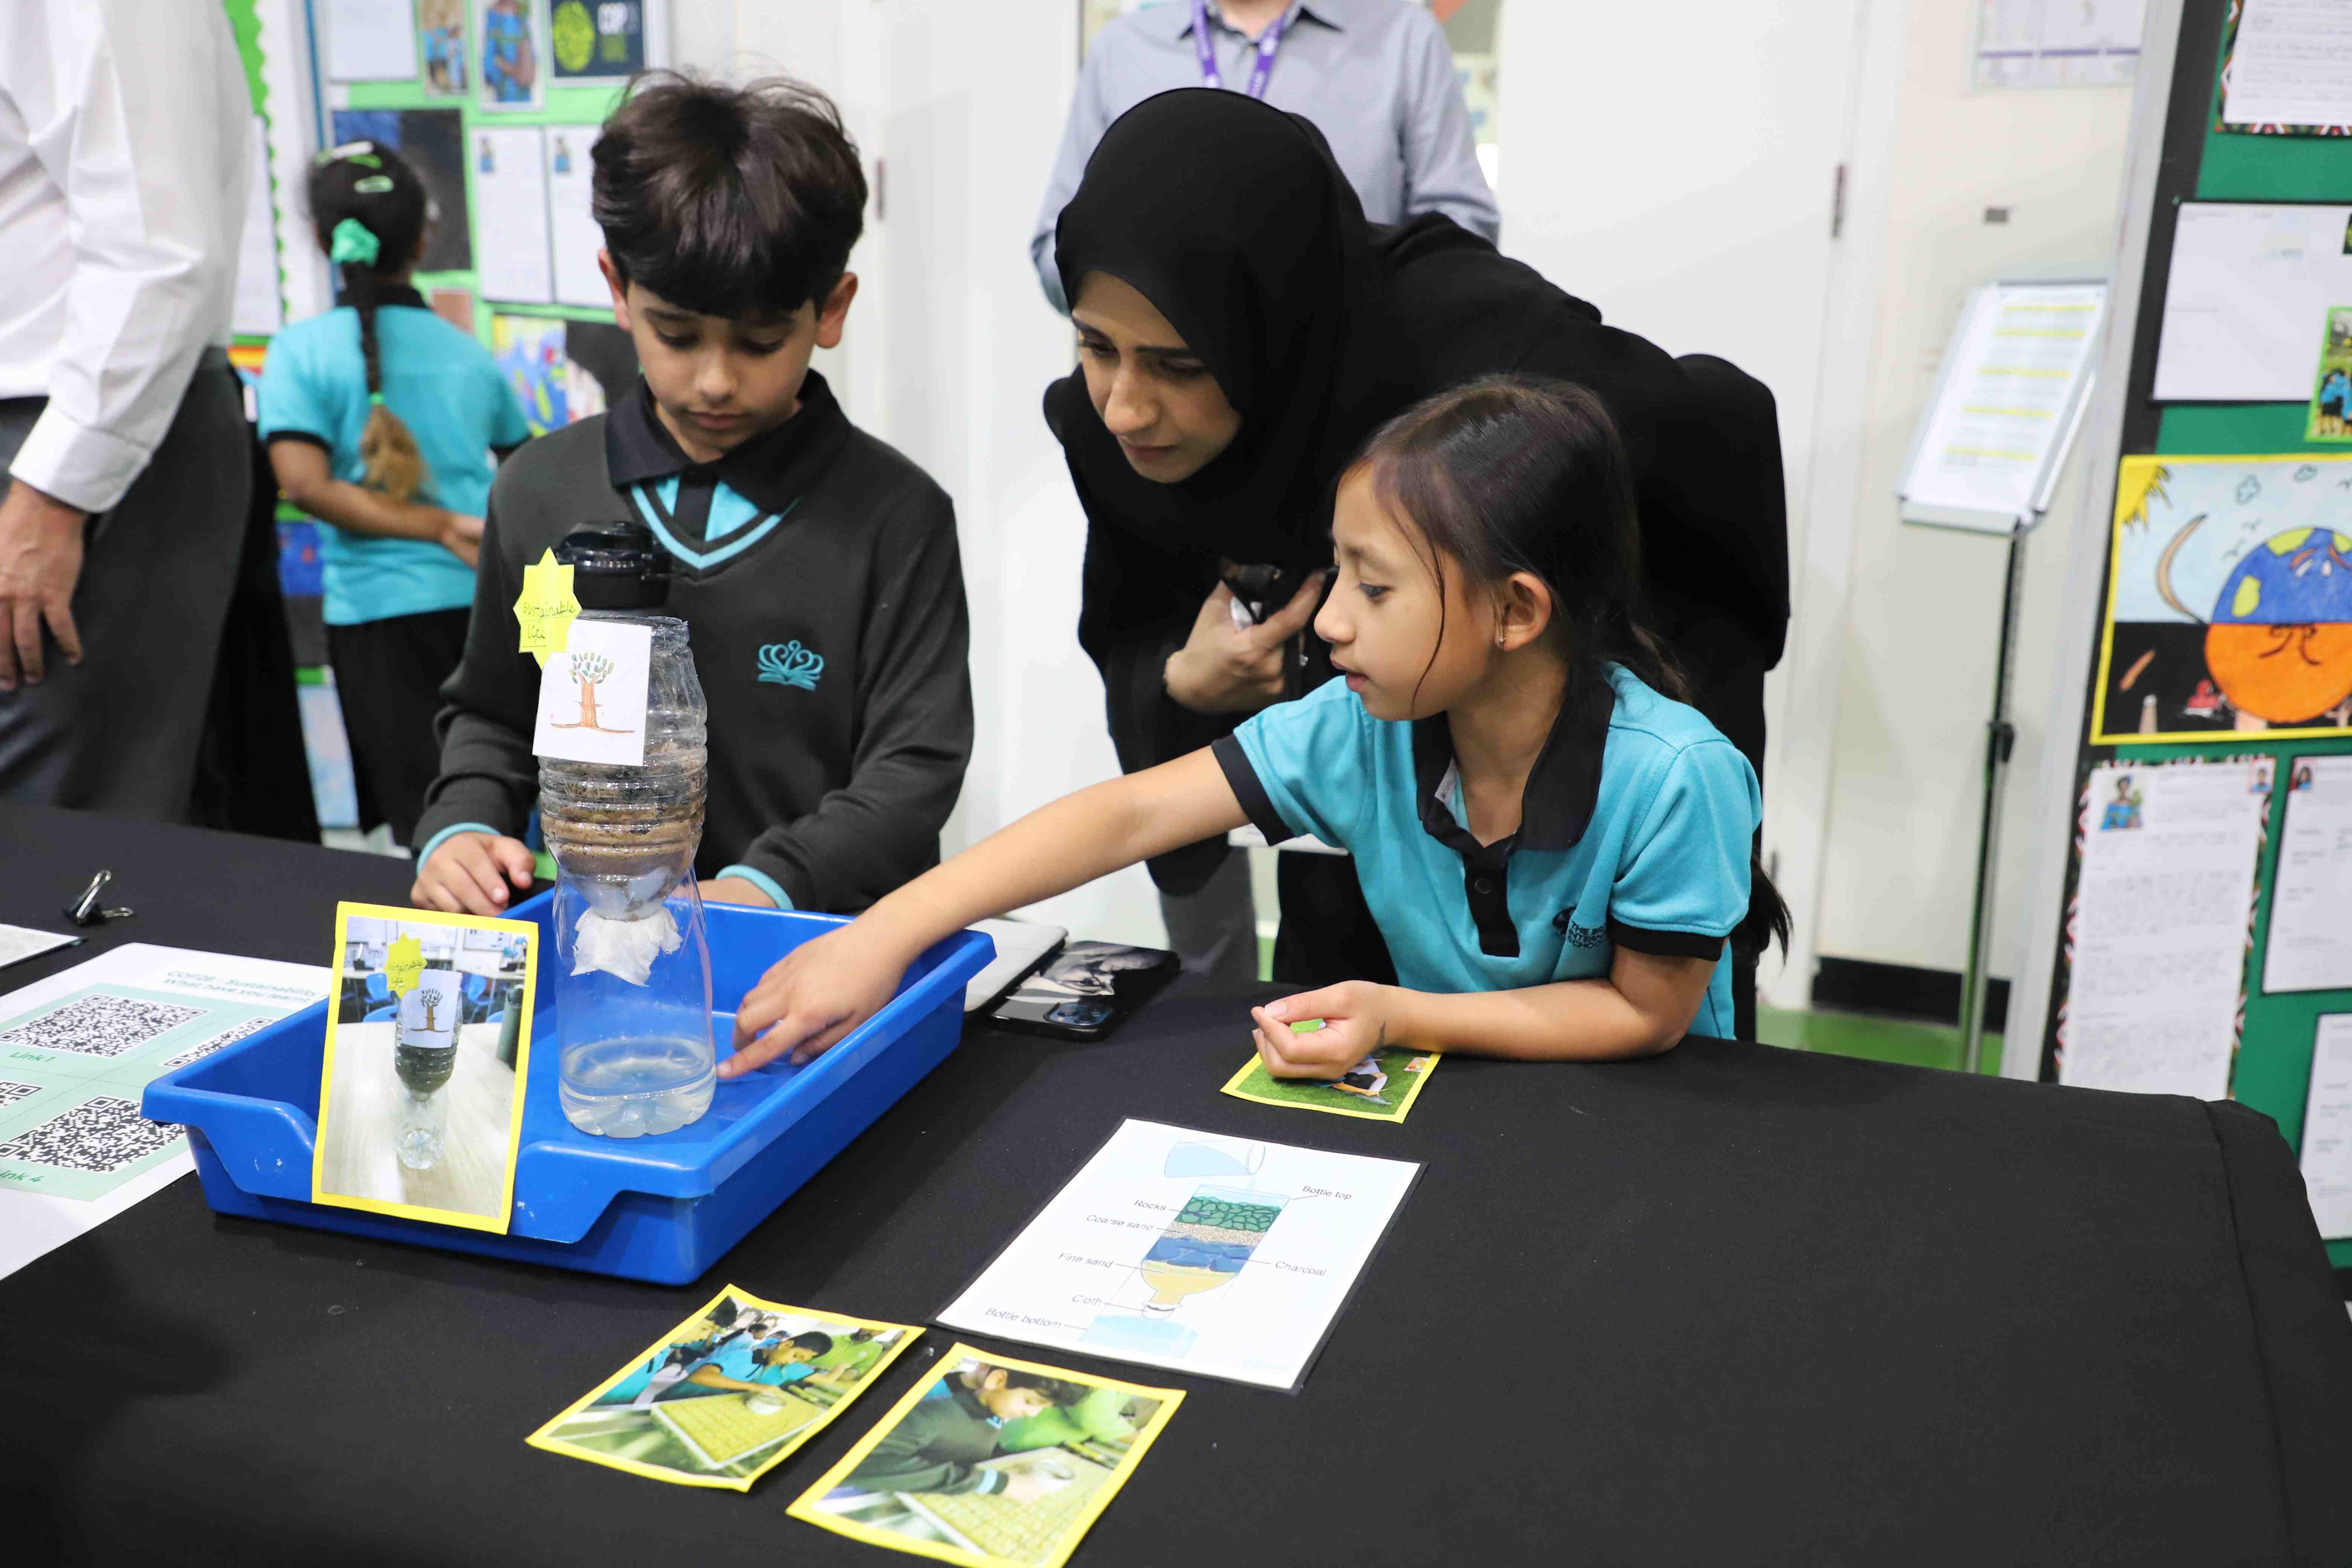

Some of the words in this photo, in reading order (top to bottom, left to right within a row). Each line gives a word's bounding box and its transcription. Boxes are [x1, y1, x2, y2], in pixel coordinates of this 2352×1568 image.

[9, 1052, 45, 1061] Link
[0, 1170, 29, 1180] ink
[1302, 1185, 1332, 1196] Bottle
[1335, 1191, 1352, 1200] top
[1133, 1200, 1167, 1211] Rocks
[1086, 1214, 1125, 1226] Coarse
[1126, 1222, 1154, 1231] sand
[1058, 1253, 1083, 1263] Fine
[1085, 1258, 1115, 1268] sand
[1275, 1260, 1327, 1276] Charcoal
[1072, 1294, 1102, 1306] Cloth
[985, 1307, 1019, 1321] Bottle
[1021, 1314, 1062, 1329] bottom
